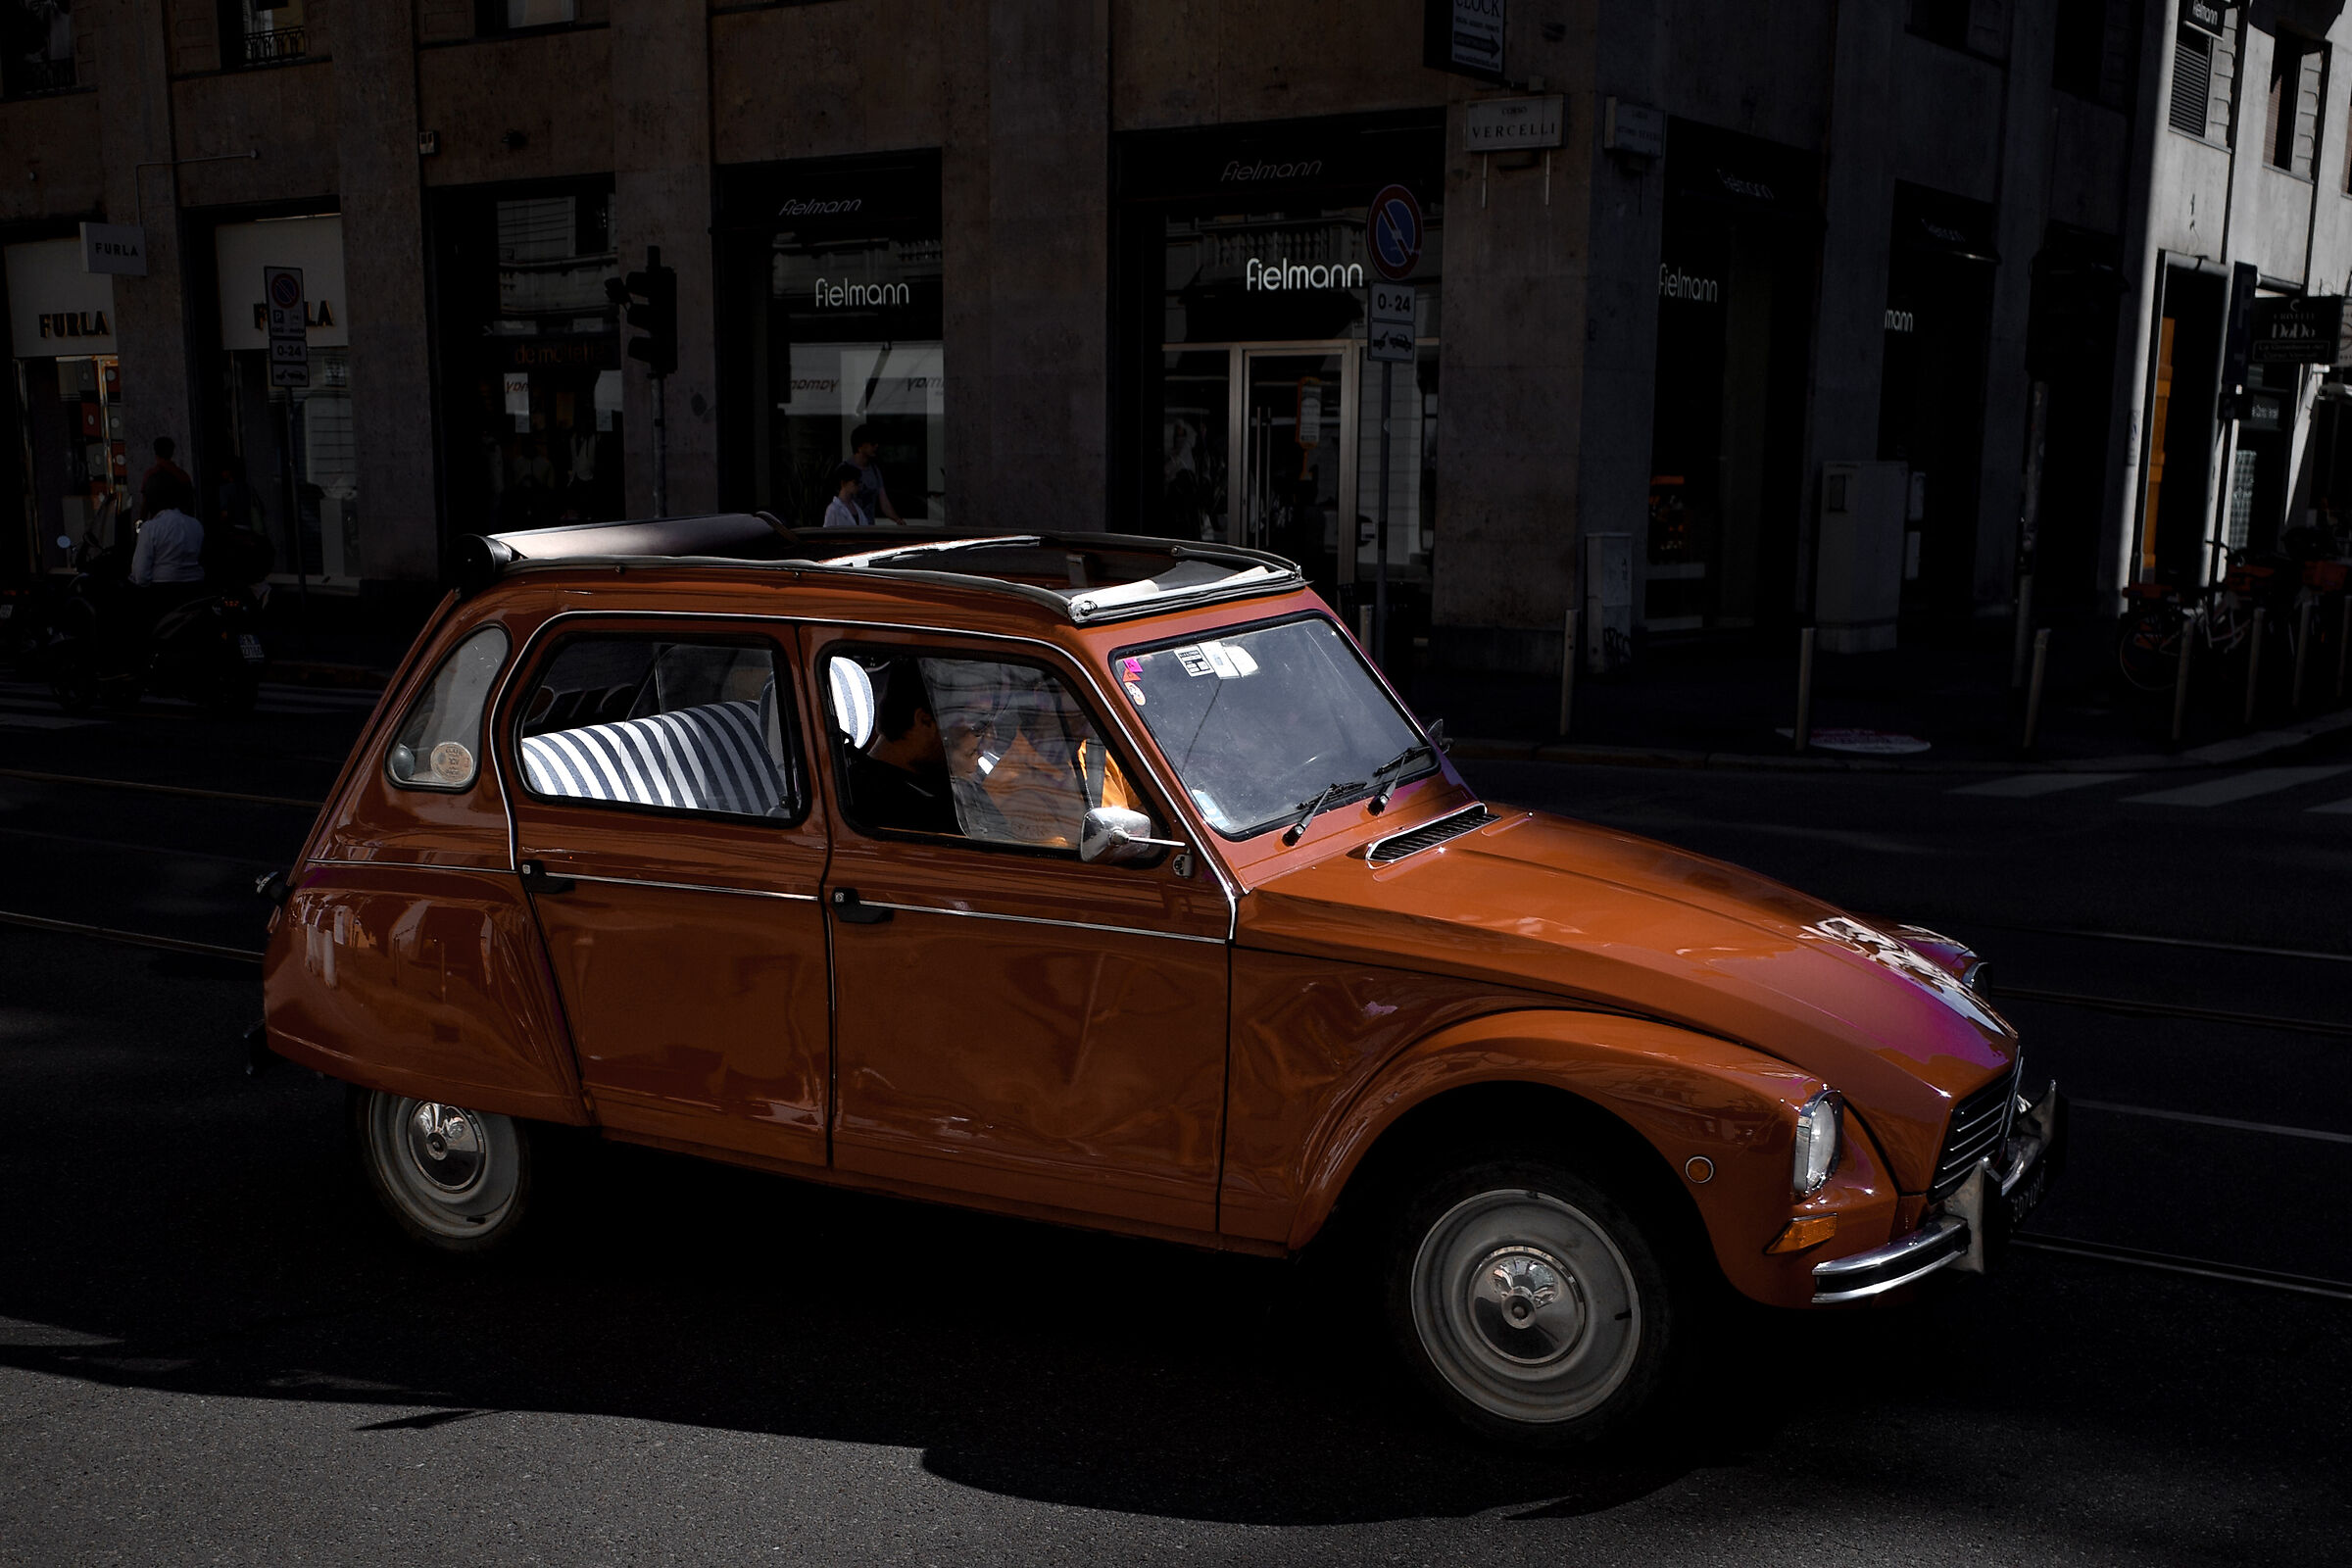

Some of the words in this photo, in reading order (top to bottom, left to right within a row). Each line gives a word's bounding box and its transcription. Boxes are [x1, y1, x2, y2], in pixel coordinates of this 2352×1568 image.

[1472, 122, 1555, 139] VERCELLI
[1220, 159, 1323, 182] fielmann
[778, 198, 862, 216] fielmann
[95, 242, 139, 256] FURLA
[1247, 258, 1364, 291] fielmann
[1658, 263, 1718, 304] fielmann
[815, 277, 910, 308] fielmann
[39, 311, 111, 338] FURLA
[253, 300, 334, 330] FLA
[276, 345, 302, 357] 0-24
